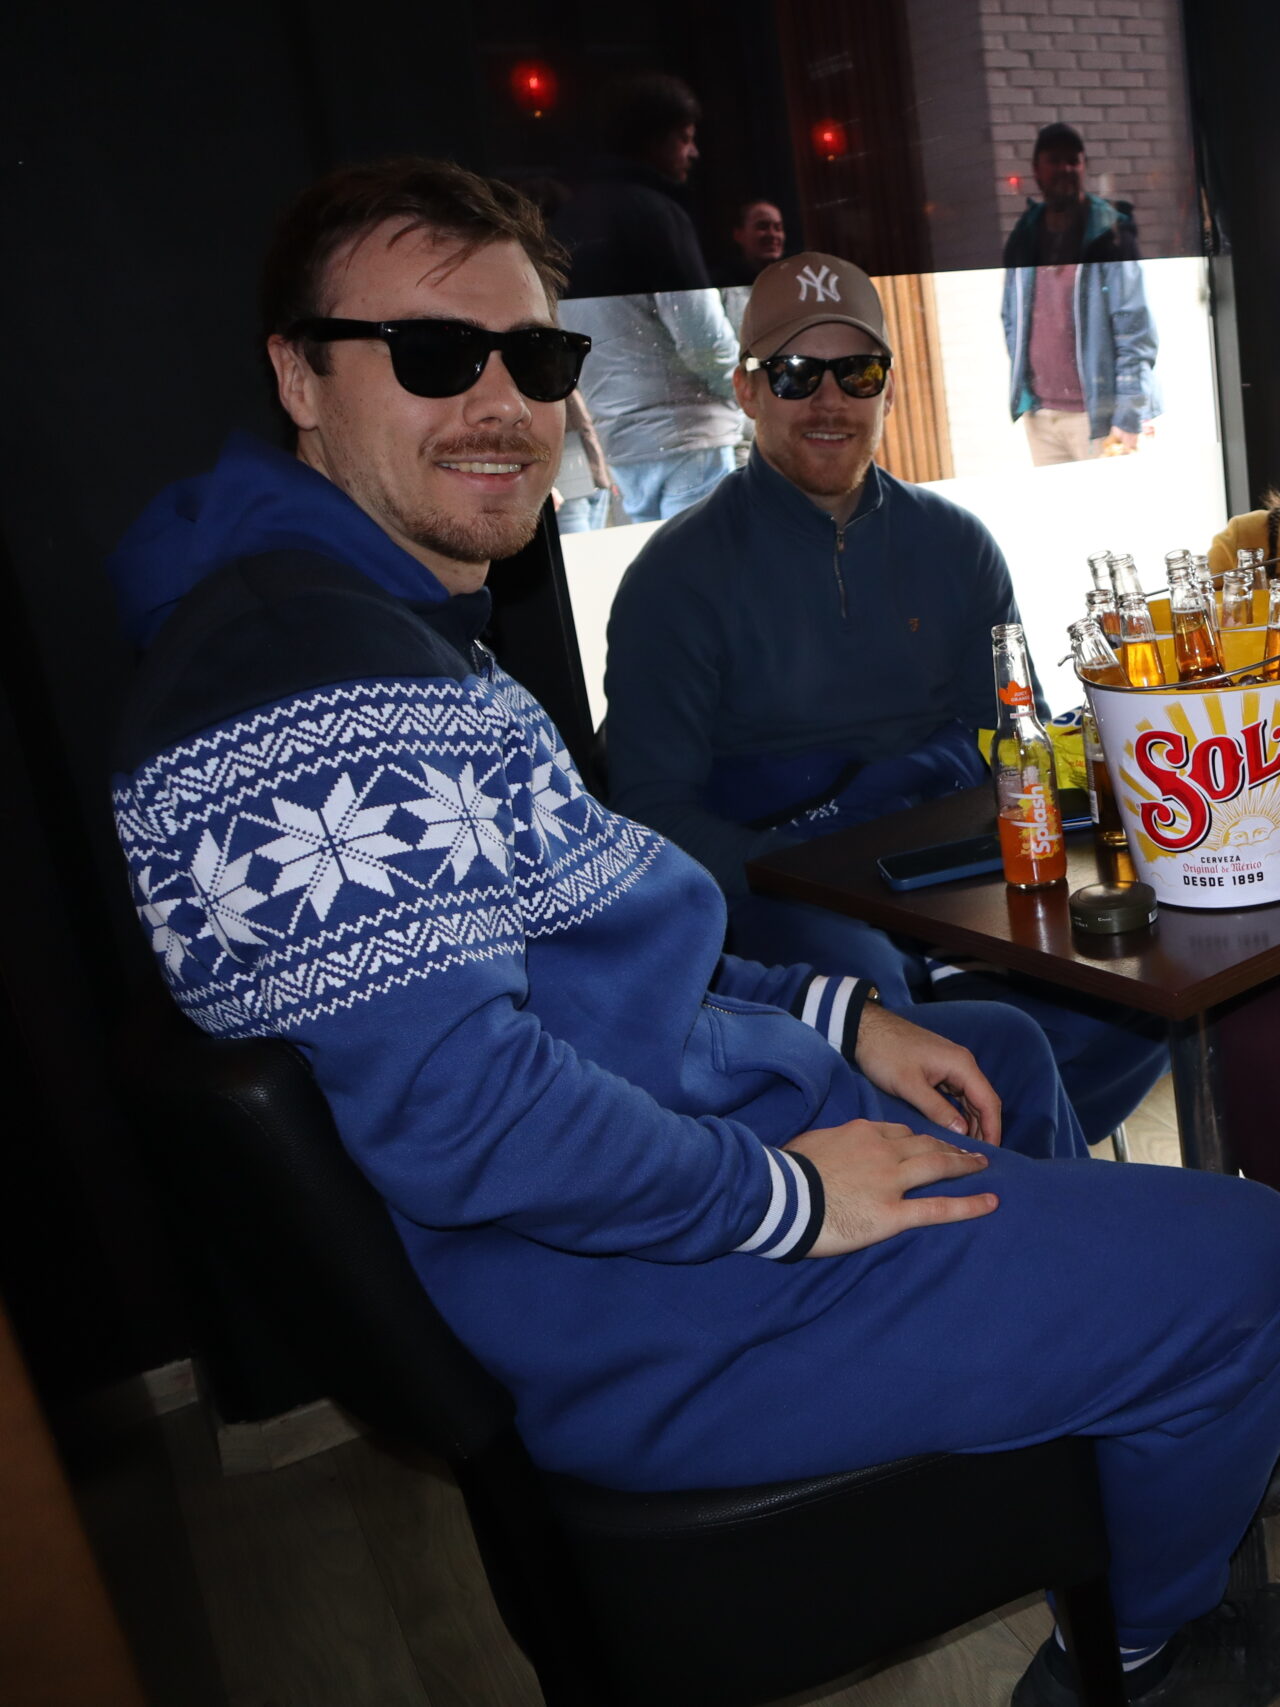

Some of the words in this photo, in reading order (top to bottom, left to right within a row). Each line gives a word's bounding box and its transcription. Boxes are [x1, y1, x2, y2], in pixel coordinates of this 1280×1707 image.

[796, 265, 840, 302] NY
[1200, 855, 1241, 864] CERVEZA
[1183, 863, 1219, 874] Original
[1183, 875, 1224, 887] DESDE
[1232, 871, 1264, 886] 1899
